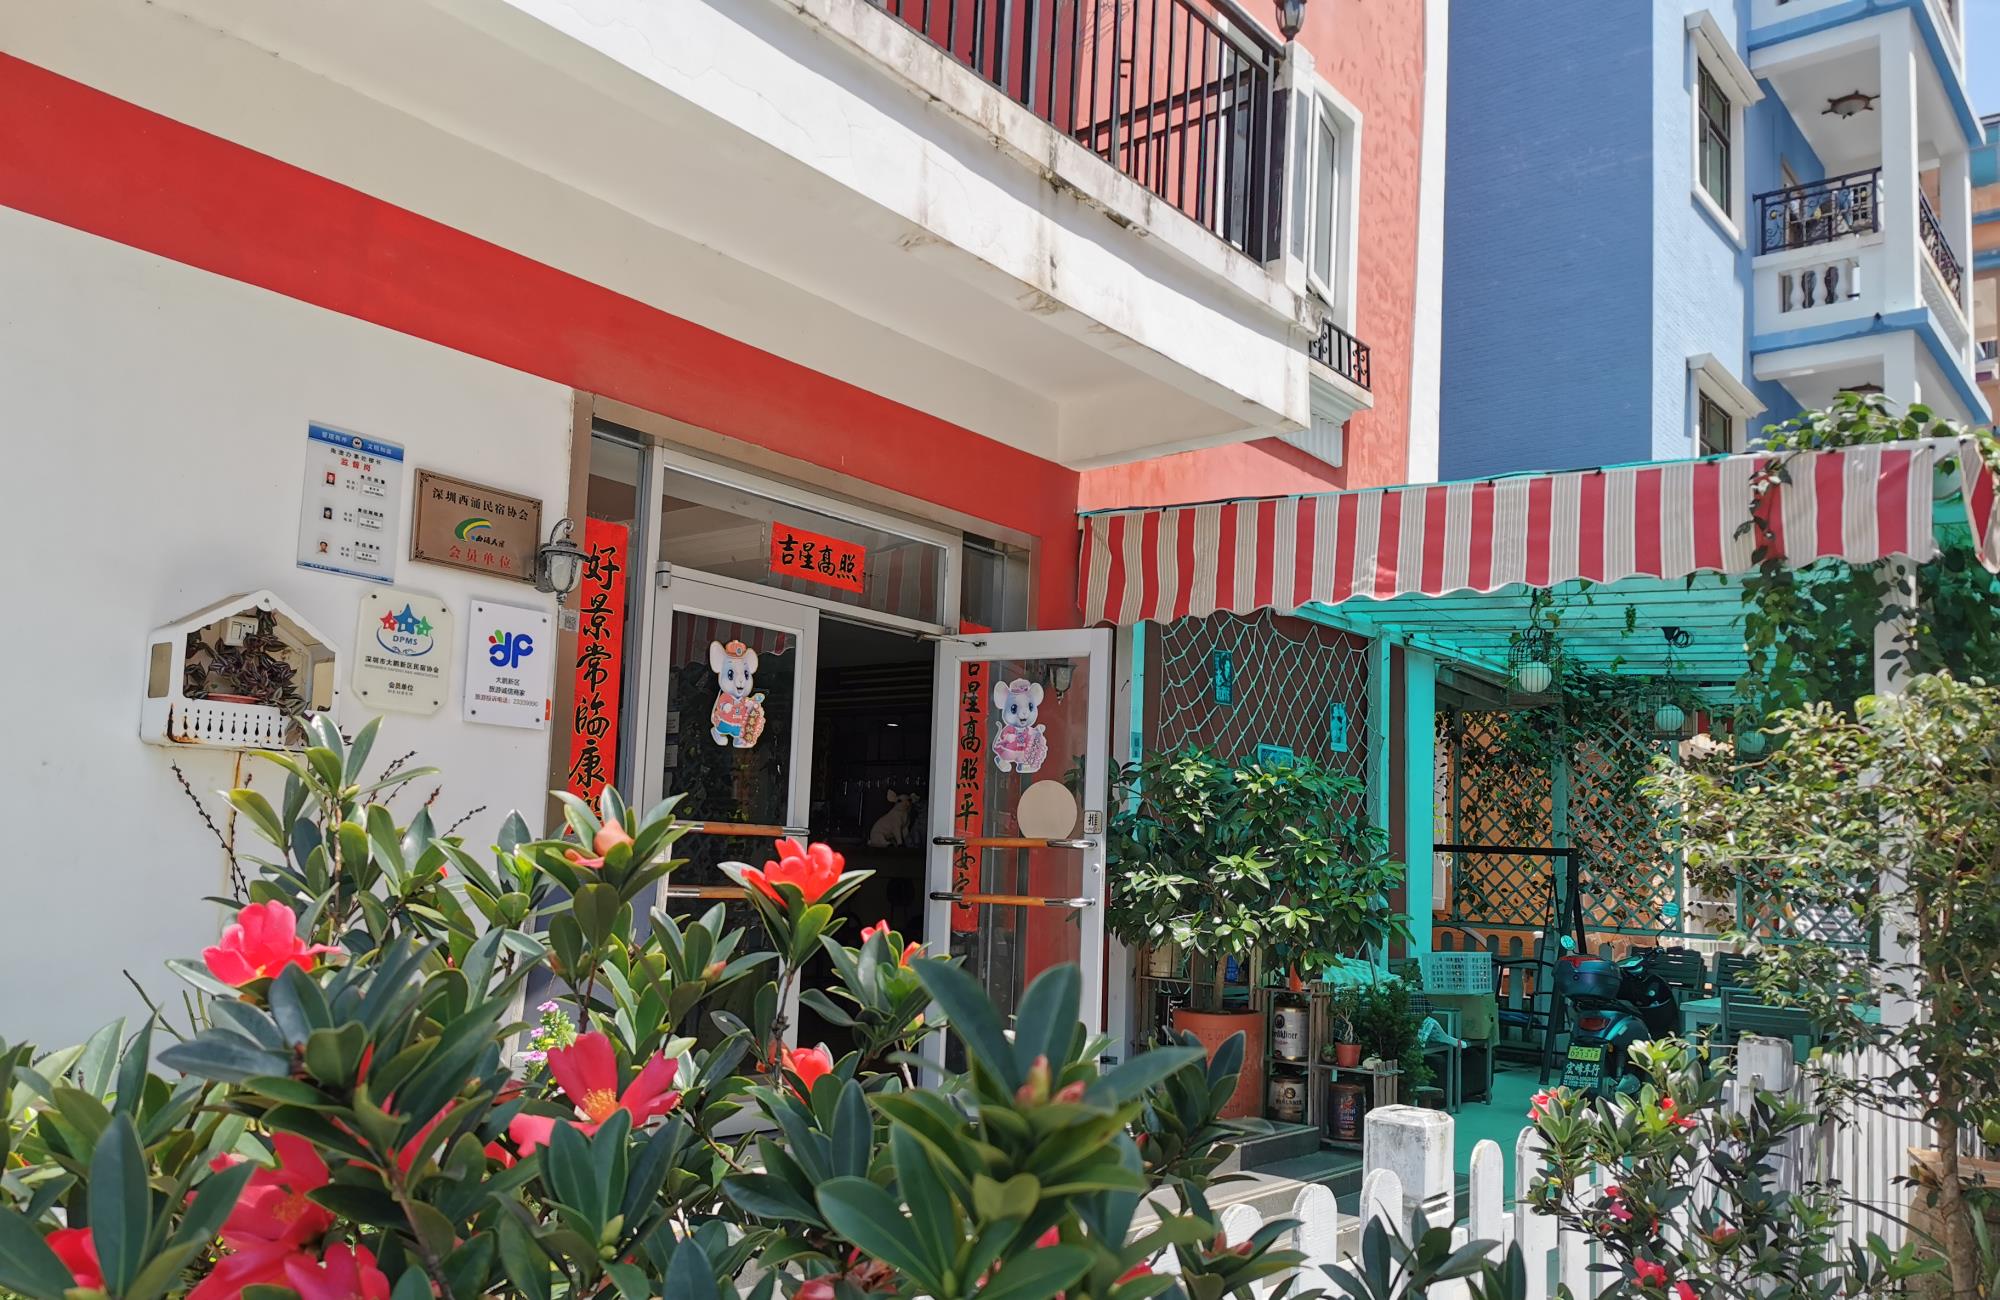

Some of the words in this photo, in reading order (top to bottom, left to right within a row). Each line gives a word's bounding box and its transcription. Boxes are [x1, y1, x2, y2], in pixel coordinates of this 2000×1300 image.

[449, 545, 511, 569] 会员单位
[777, 533, 858, 583] 吉星高照
[392, 634, 419, 647] DPMS
[388, 681, 415, 692] 会员单位
